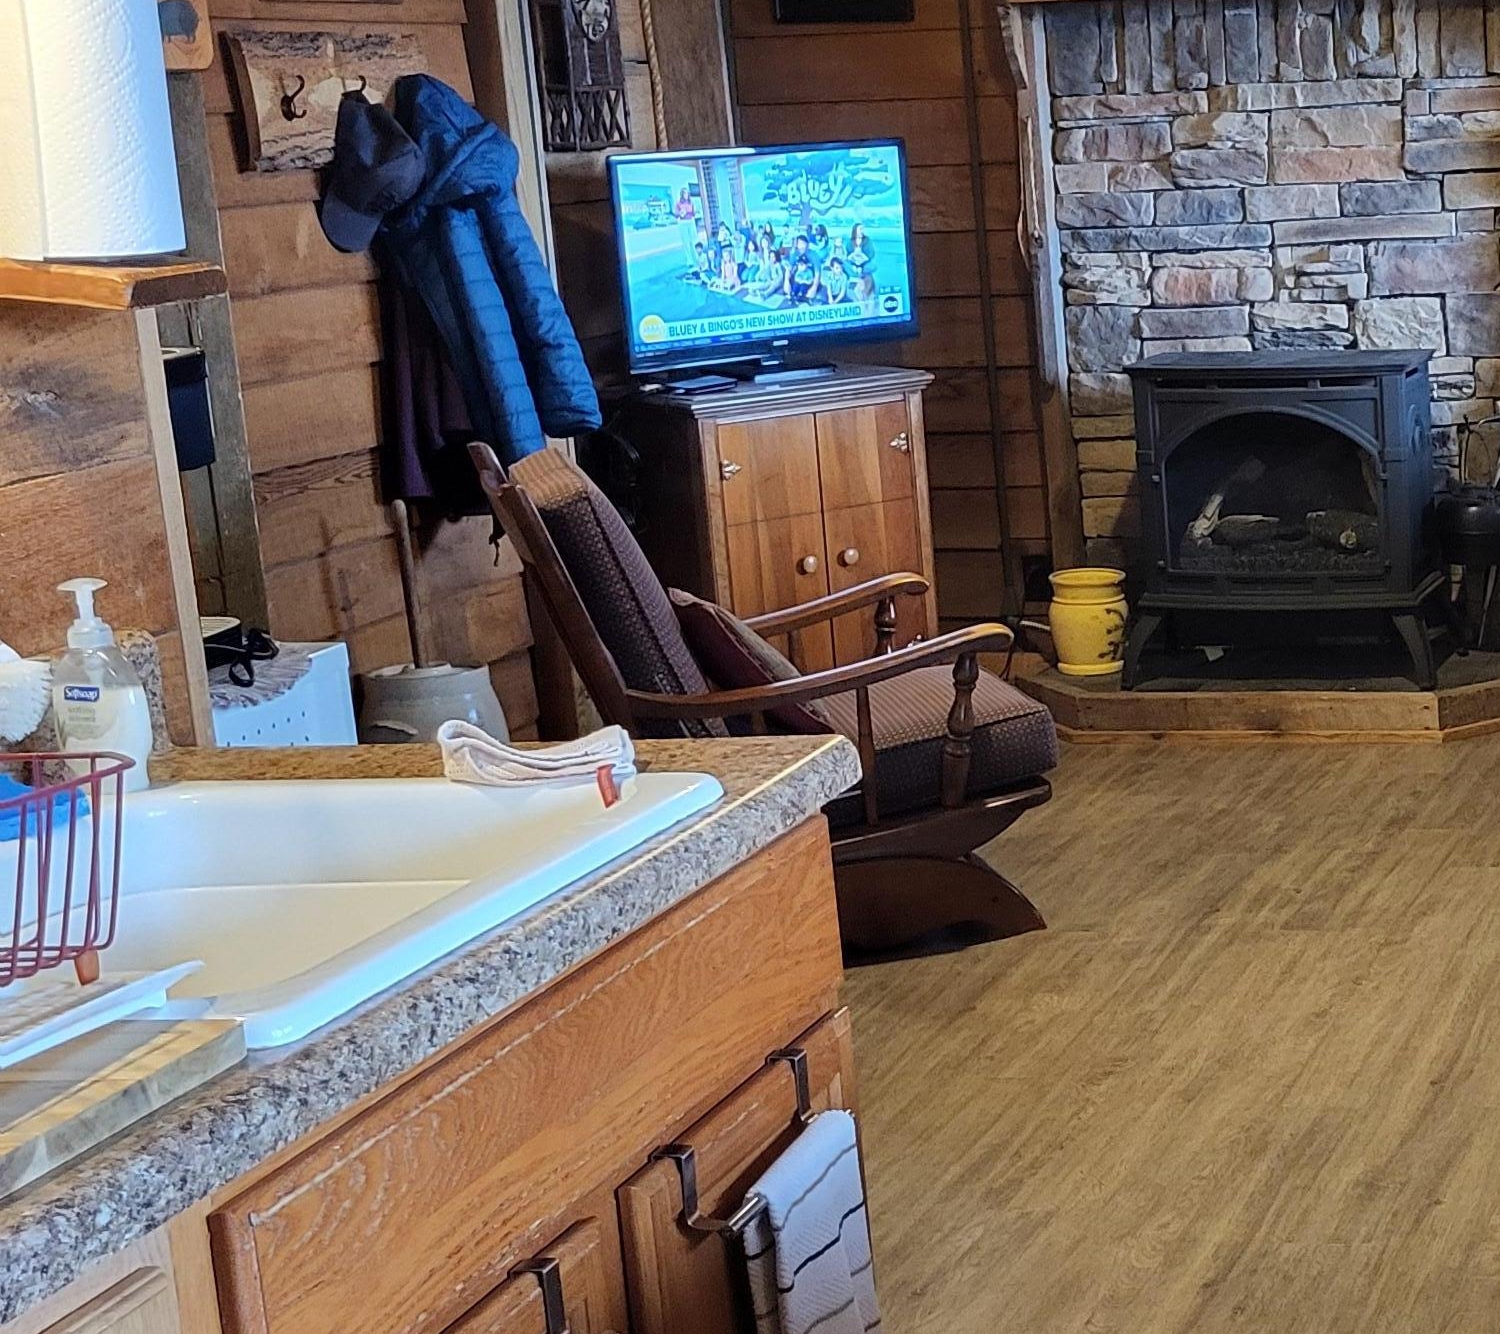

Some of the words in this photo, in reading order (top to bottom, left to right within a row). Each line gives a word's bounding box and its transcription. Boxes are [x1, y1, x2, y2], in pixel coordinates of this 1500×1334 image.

[668, 323, 698, 338] BLUEY
[700, 323, 707, 334] &
[708, 319, 745, 332] BINGO'S
[746, 315, 766, 328] NEW
[768, 312, 794, 326] SHOW
[795, 310, 808, 322] AT
[809, 304, 862, 321] DISNEYLAND
[65, 687, 98, 702] Softsoap
